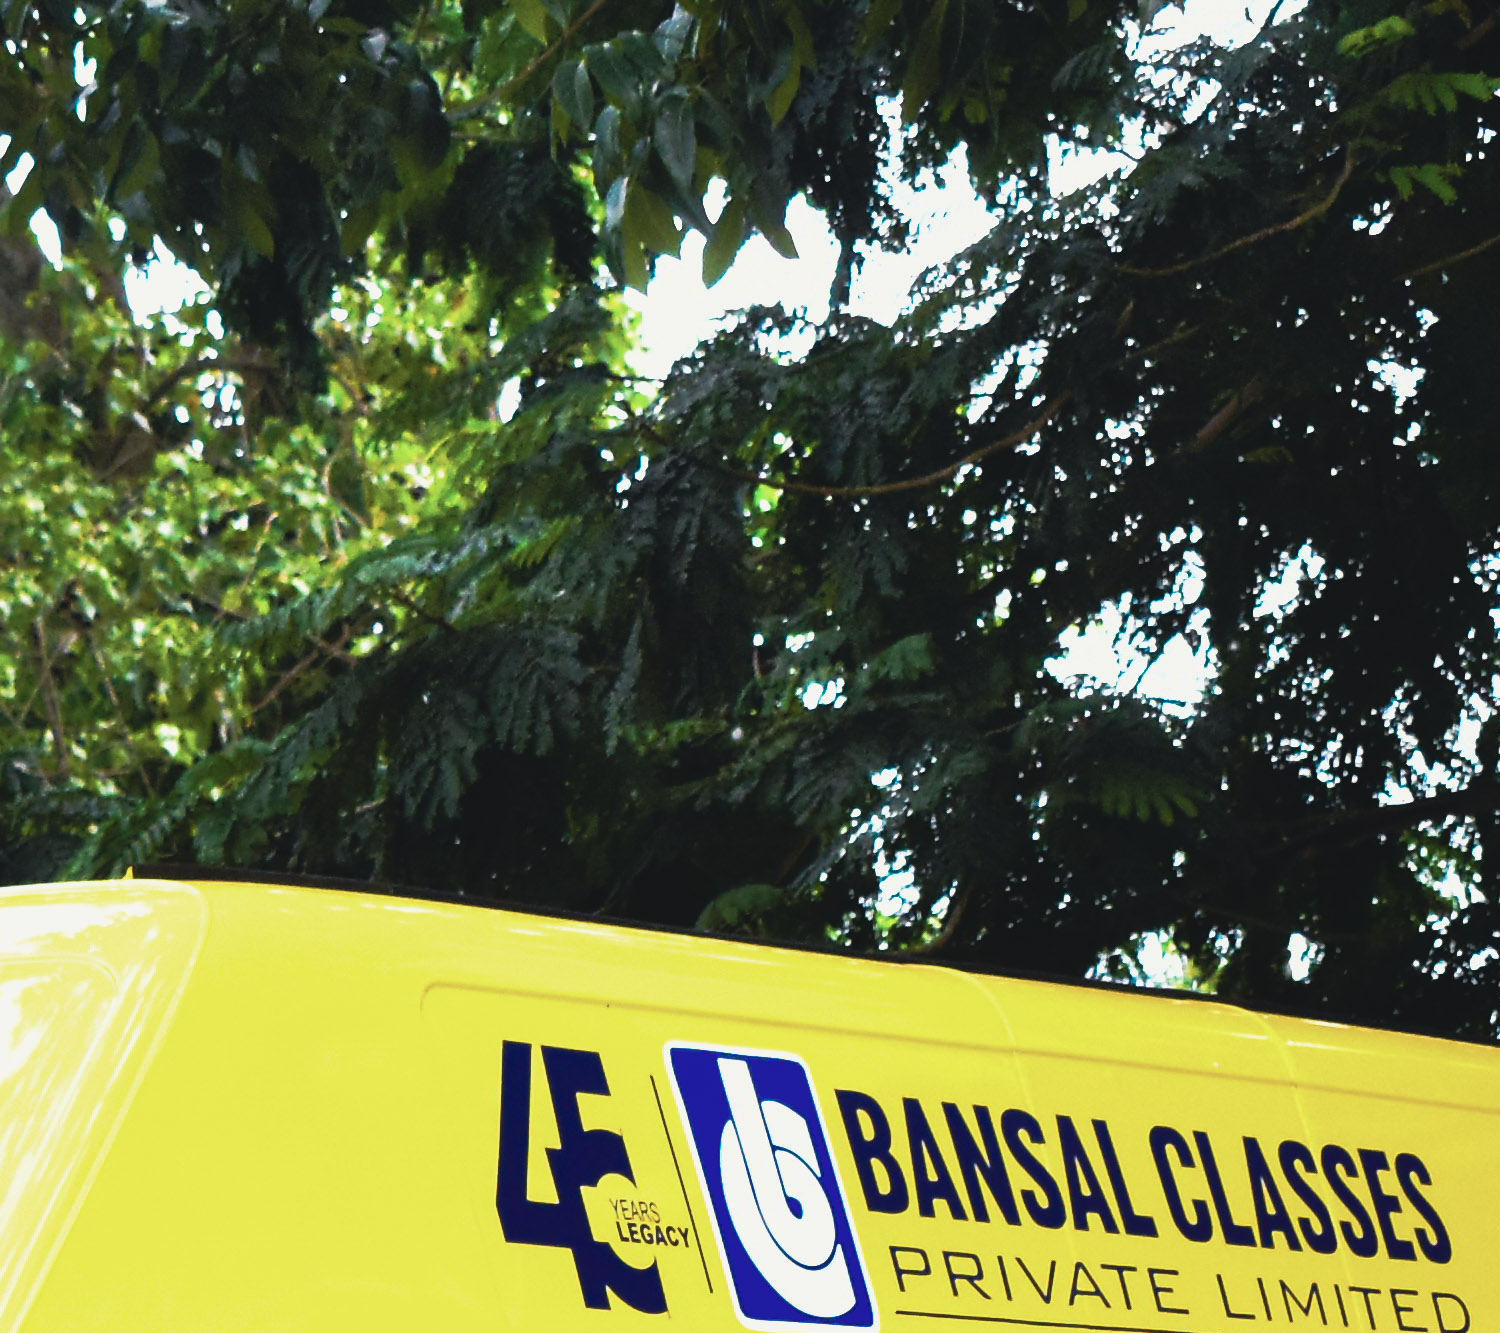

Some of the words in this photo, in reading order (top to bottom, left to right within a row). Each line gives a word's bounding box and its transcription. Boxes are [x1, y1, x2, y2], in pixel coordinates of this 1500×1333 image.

[834, 1088, 1159, 1238] BANSAL
[1149, 1125, 1453, 1264] CLASSES
[610, 1199, 660, 1224] YEARS
[616, 1221, 689, 1248] LEGACY
[889, 1246, 1190, 1315] PRIVATE
